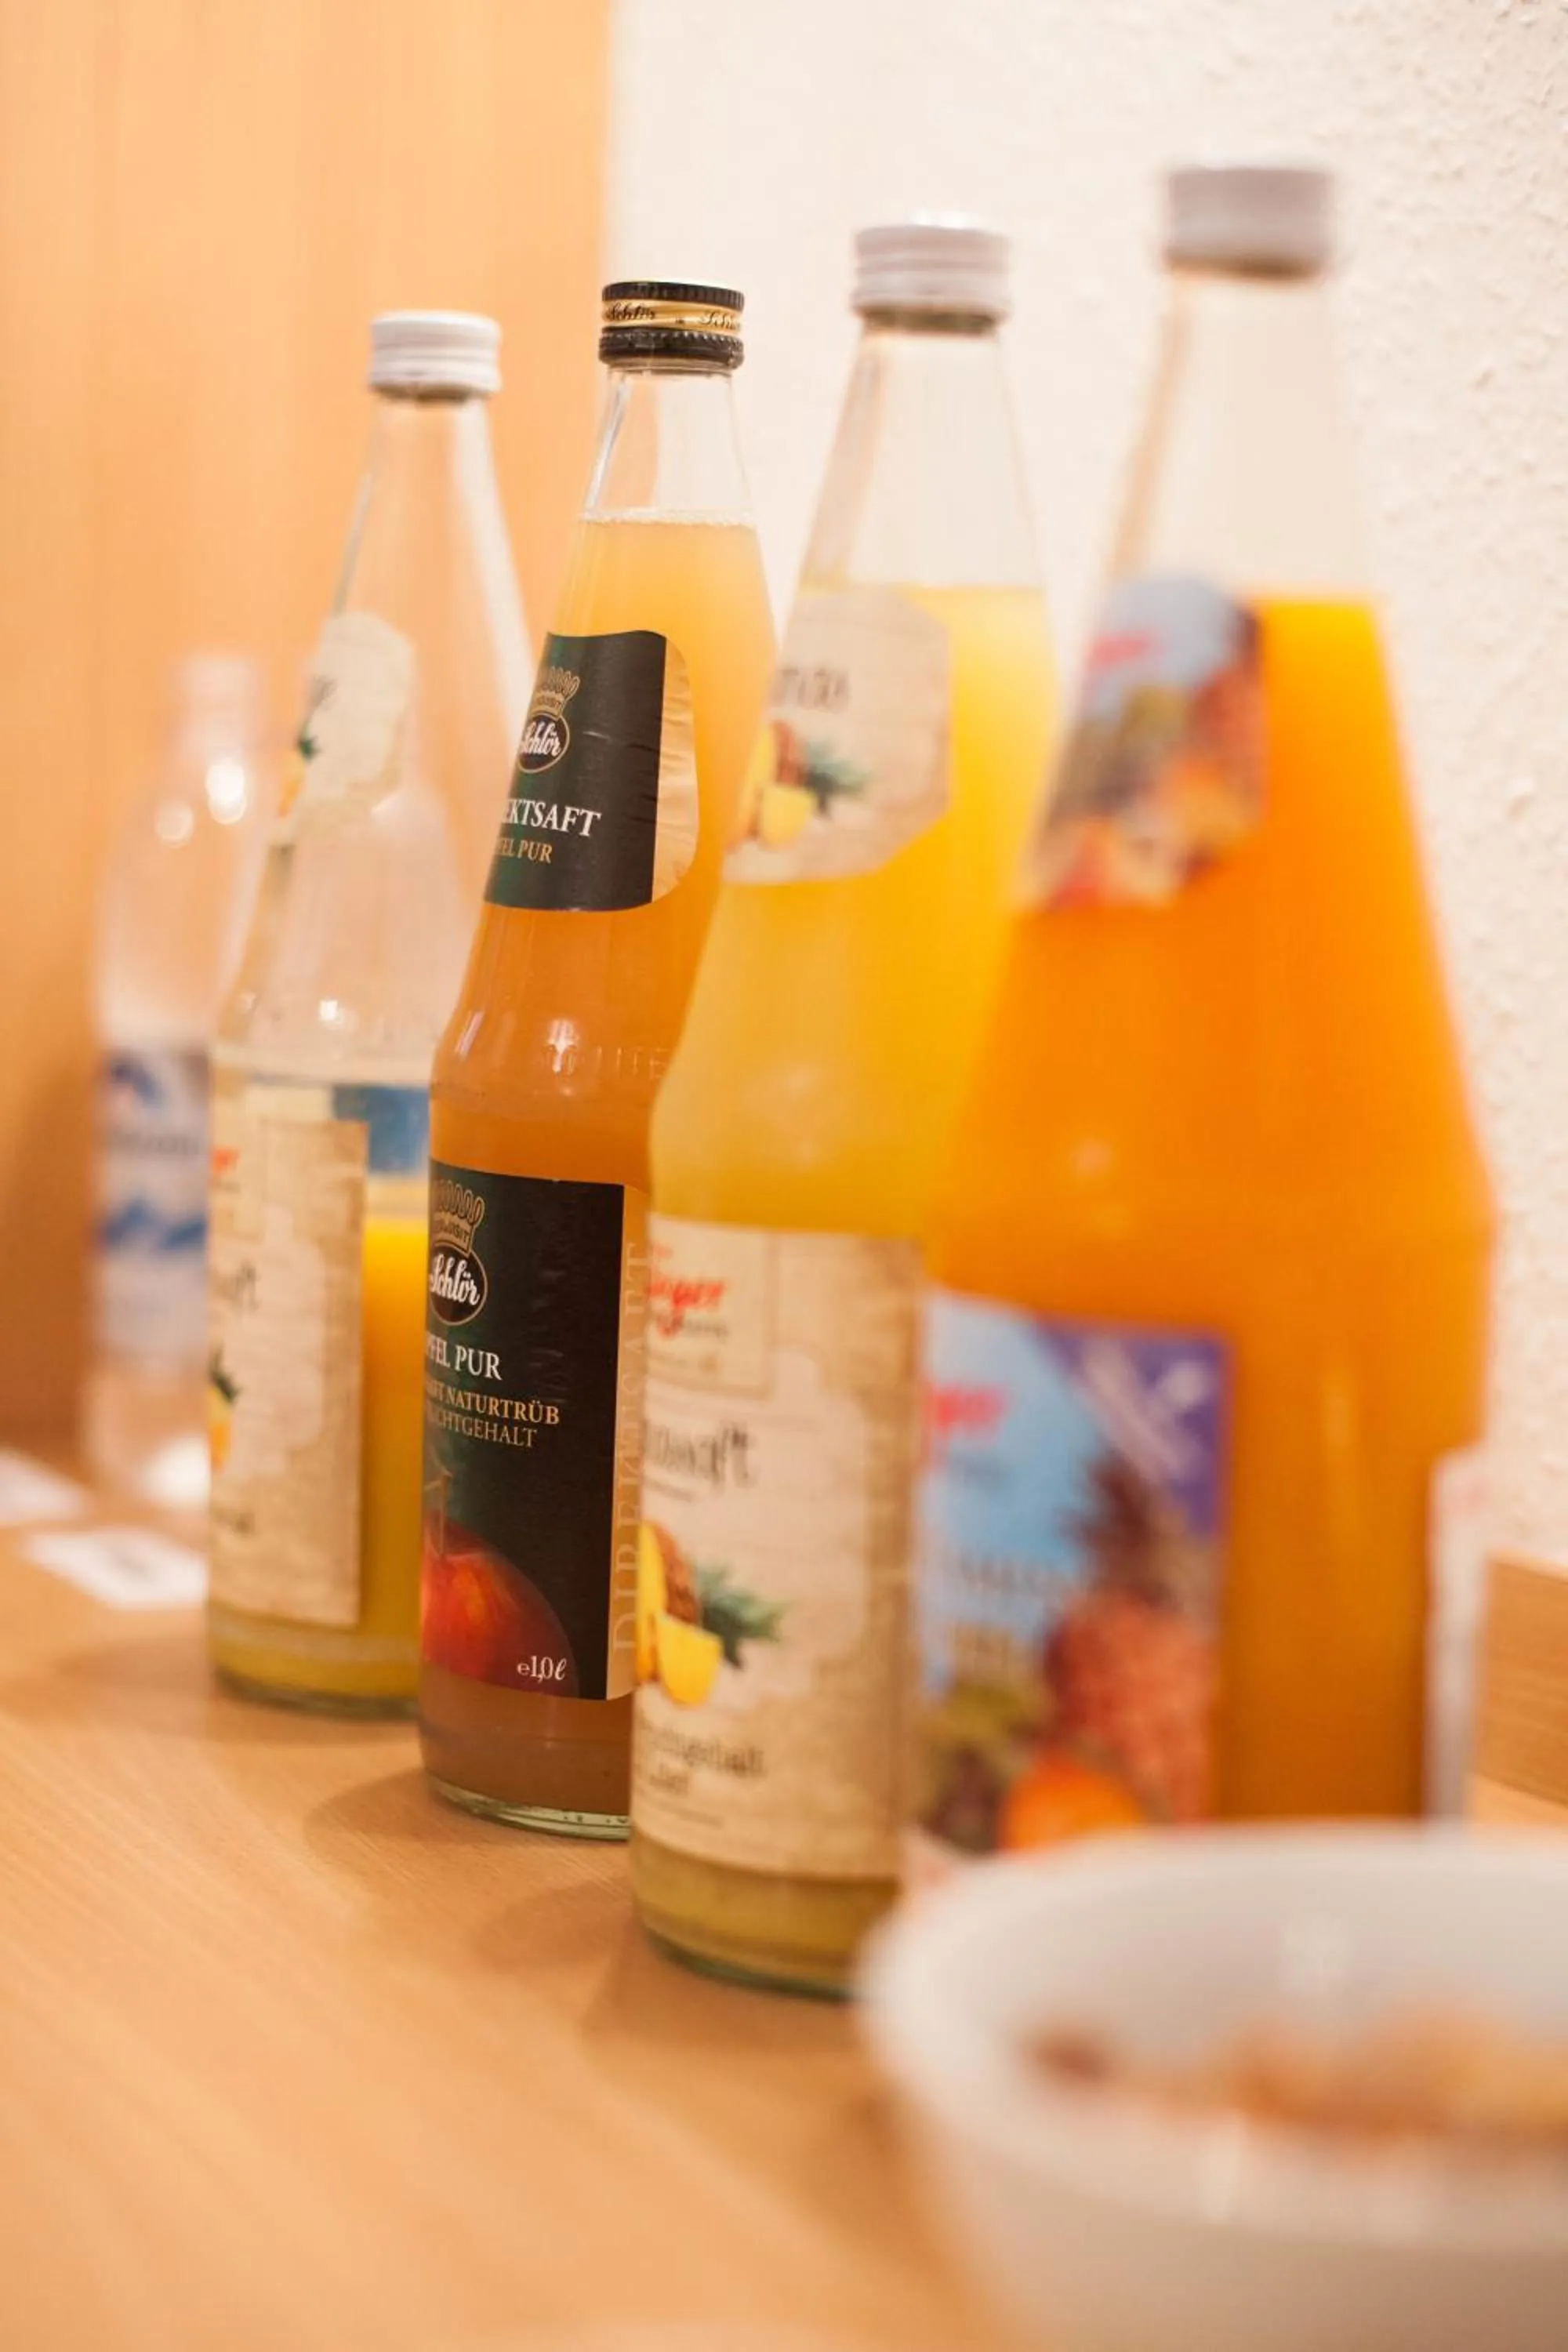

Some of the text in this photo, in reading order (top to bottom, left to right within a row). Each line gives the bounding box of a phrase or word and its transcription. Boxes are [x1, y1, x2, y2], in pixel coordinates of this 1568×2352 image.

[517, 839, 553, 864] PUR
[455, 1343, 503, 1381] PUR
[445, 1385, 560, 1425] NATURTRÜB
